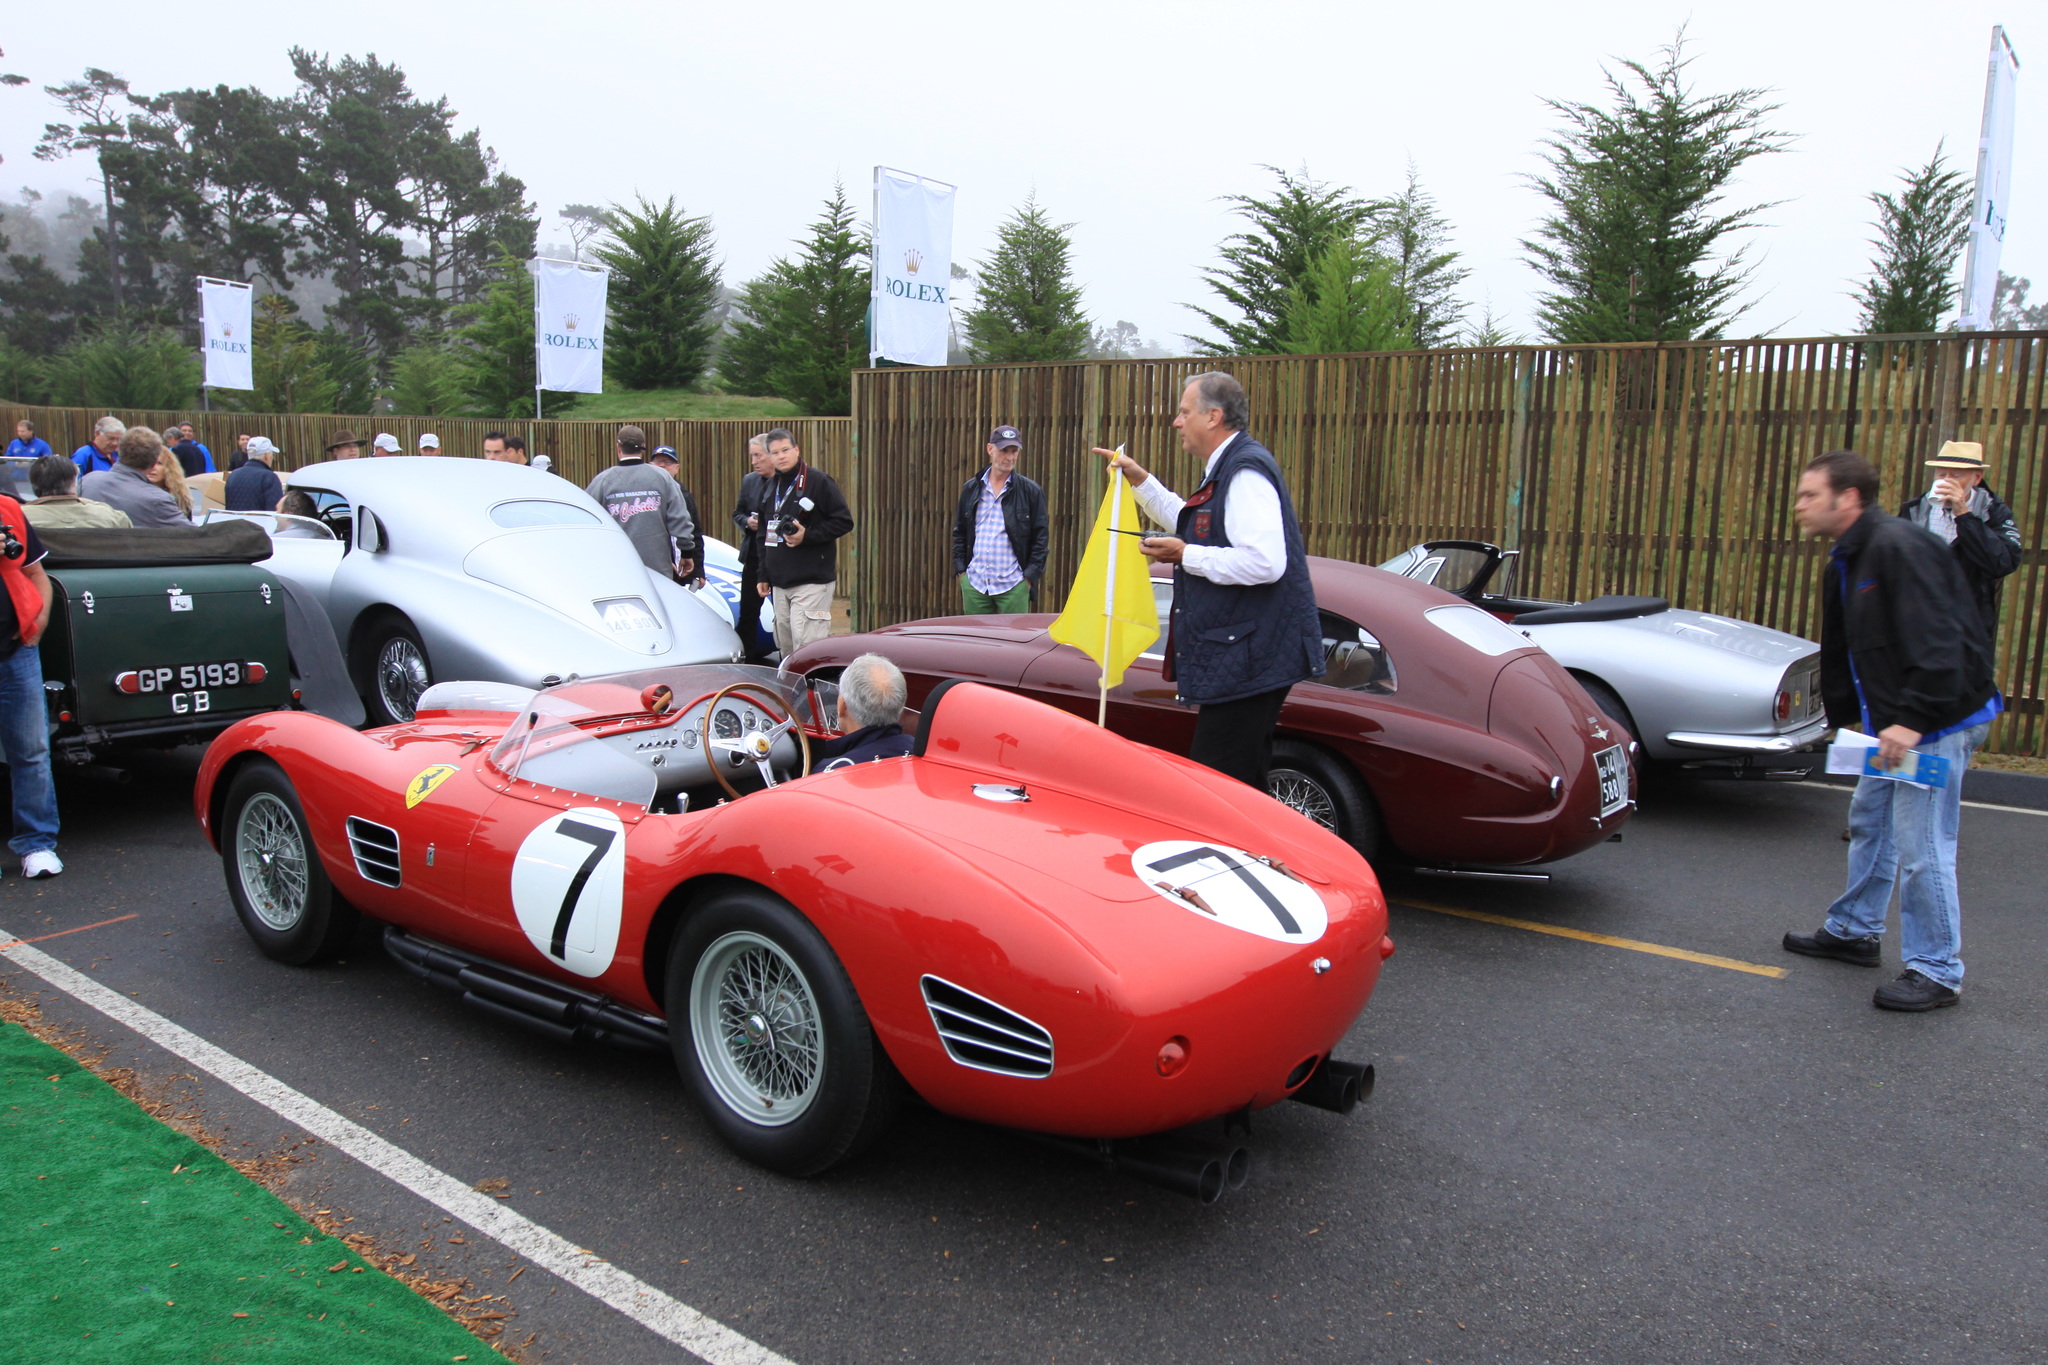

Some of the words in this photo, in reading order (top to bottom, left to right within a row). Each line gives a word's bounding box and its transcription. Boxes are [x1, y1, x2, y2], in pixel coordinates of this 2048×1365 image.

[885, 275, 946, 304] ROLEX
[210, 338, 248, 354] ROLEX
[544, 333, 599, 350] ROLEX
[614, 604, 630, 617] IT
[606, 618, 632, 633] 146
[633, 615, 658, 630] 901
[138, 667, 173, 692] GP
[180, 662, 240, 689] 5193
[171, 690, 210, 714] GB
[1605, 754, 1616, 775] 14
[1602, 778, 1619, 802] 588
[551, 818, 617, 961] 7
[1145, 846, 1303, 934] 7
